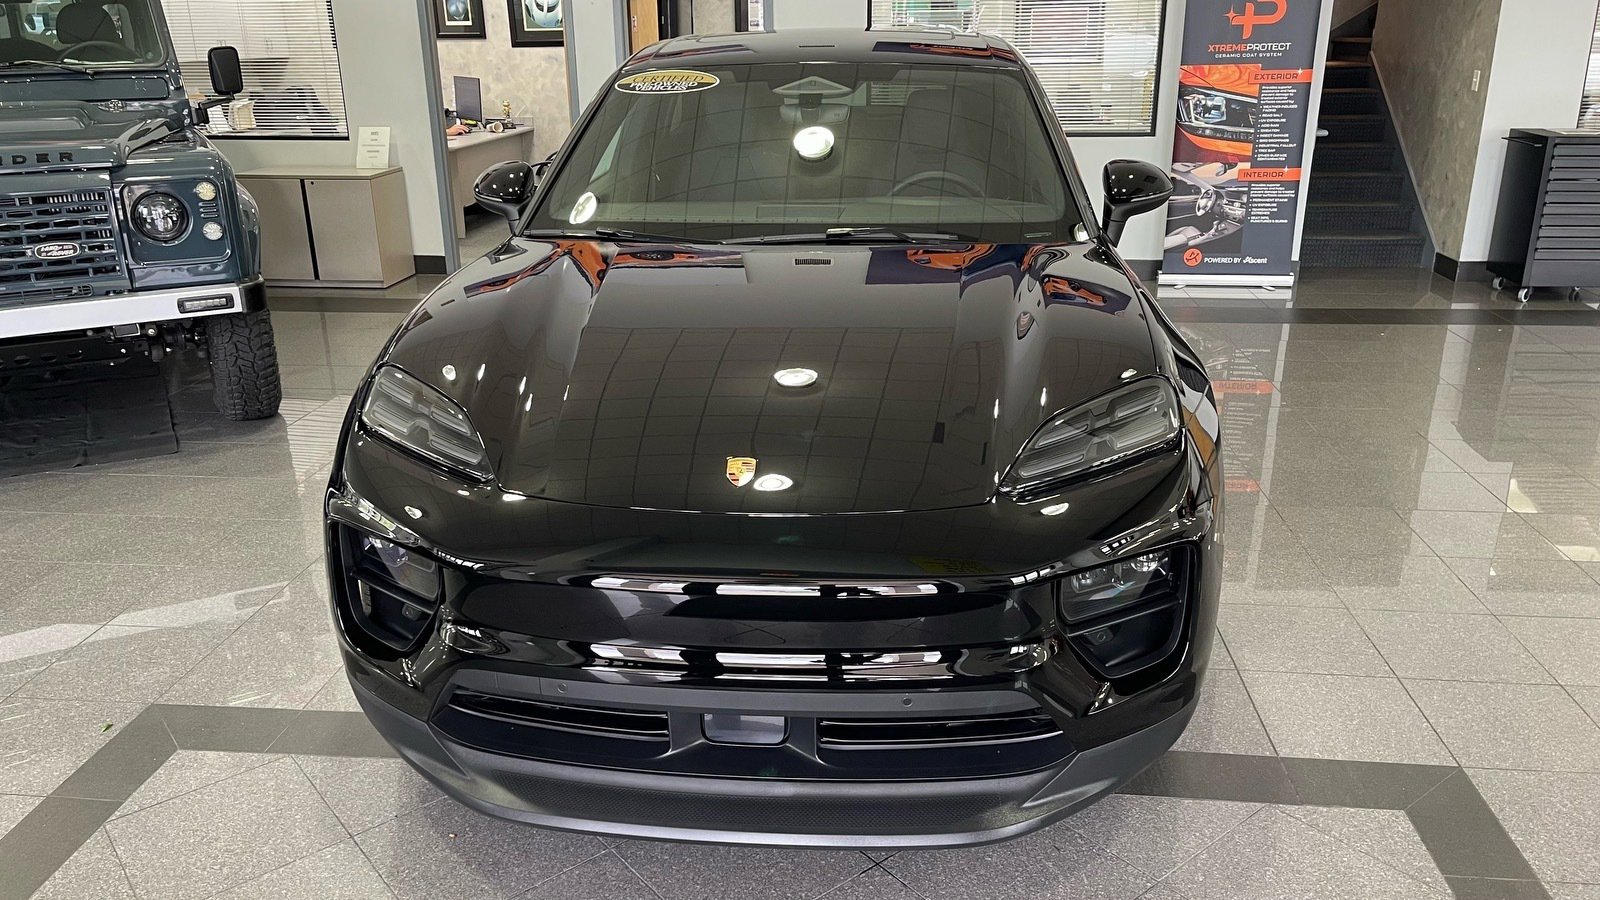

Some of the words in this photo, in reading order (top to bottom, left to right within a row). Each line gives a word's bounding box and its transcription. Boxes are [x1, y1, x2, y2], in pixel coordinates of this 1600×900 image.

[632, 74, 704, 83] CERTIFIED
[1254, 73, 1299, 81] EXTERIOR
[0, 151, 73, 166] DER
